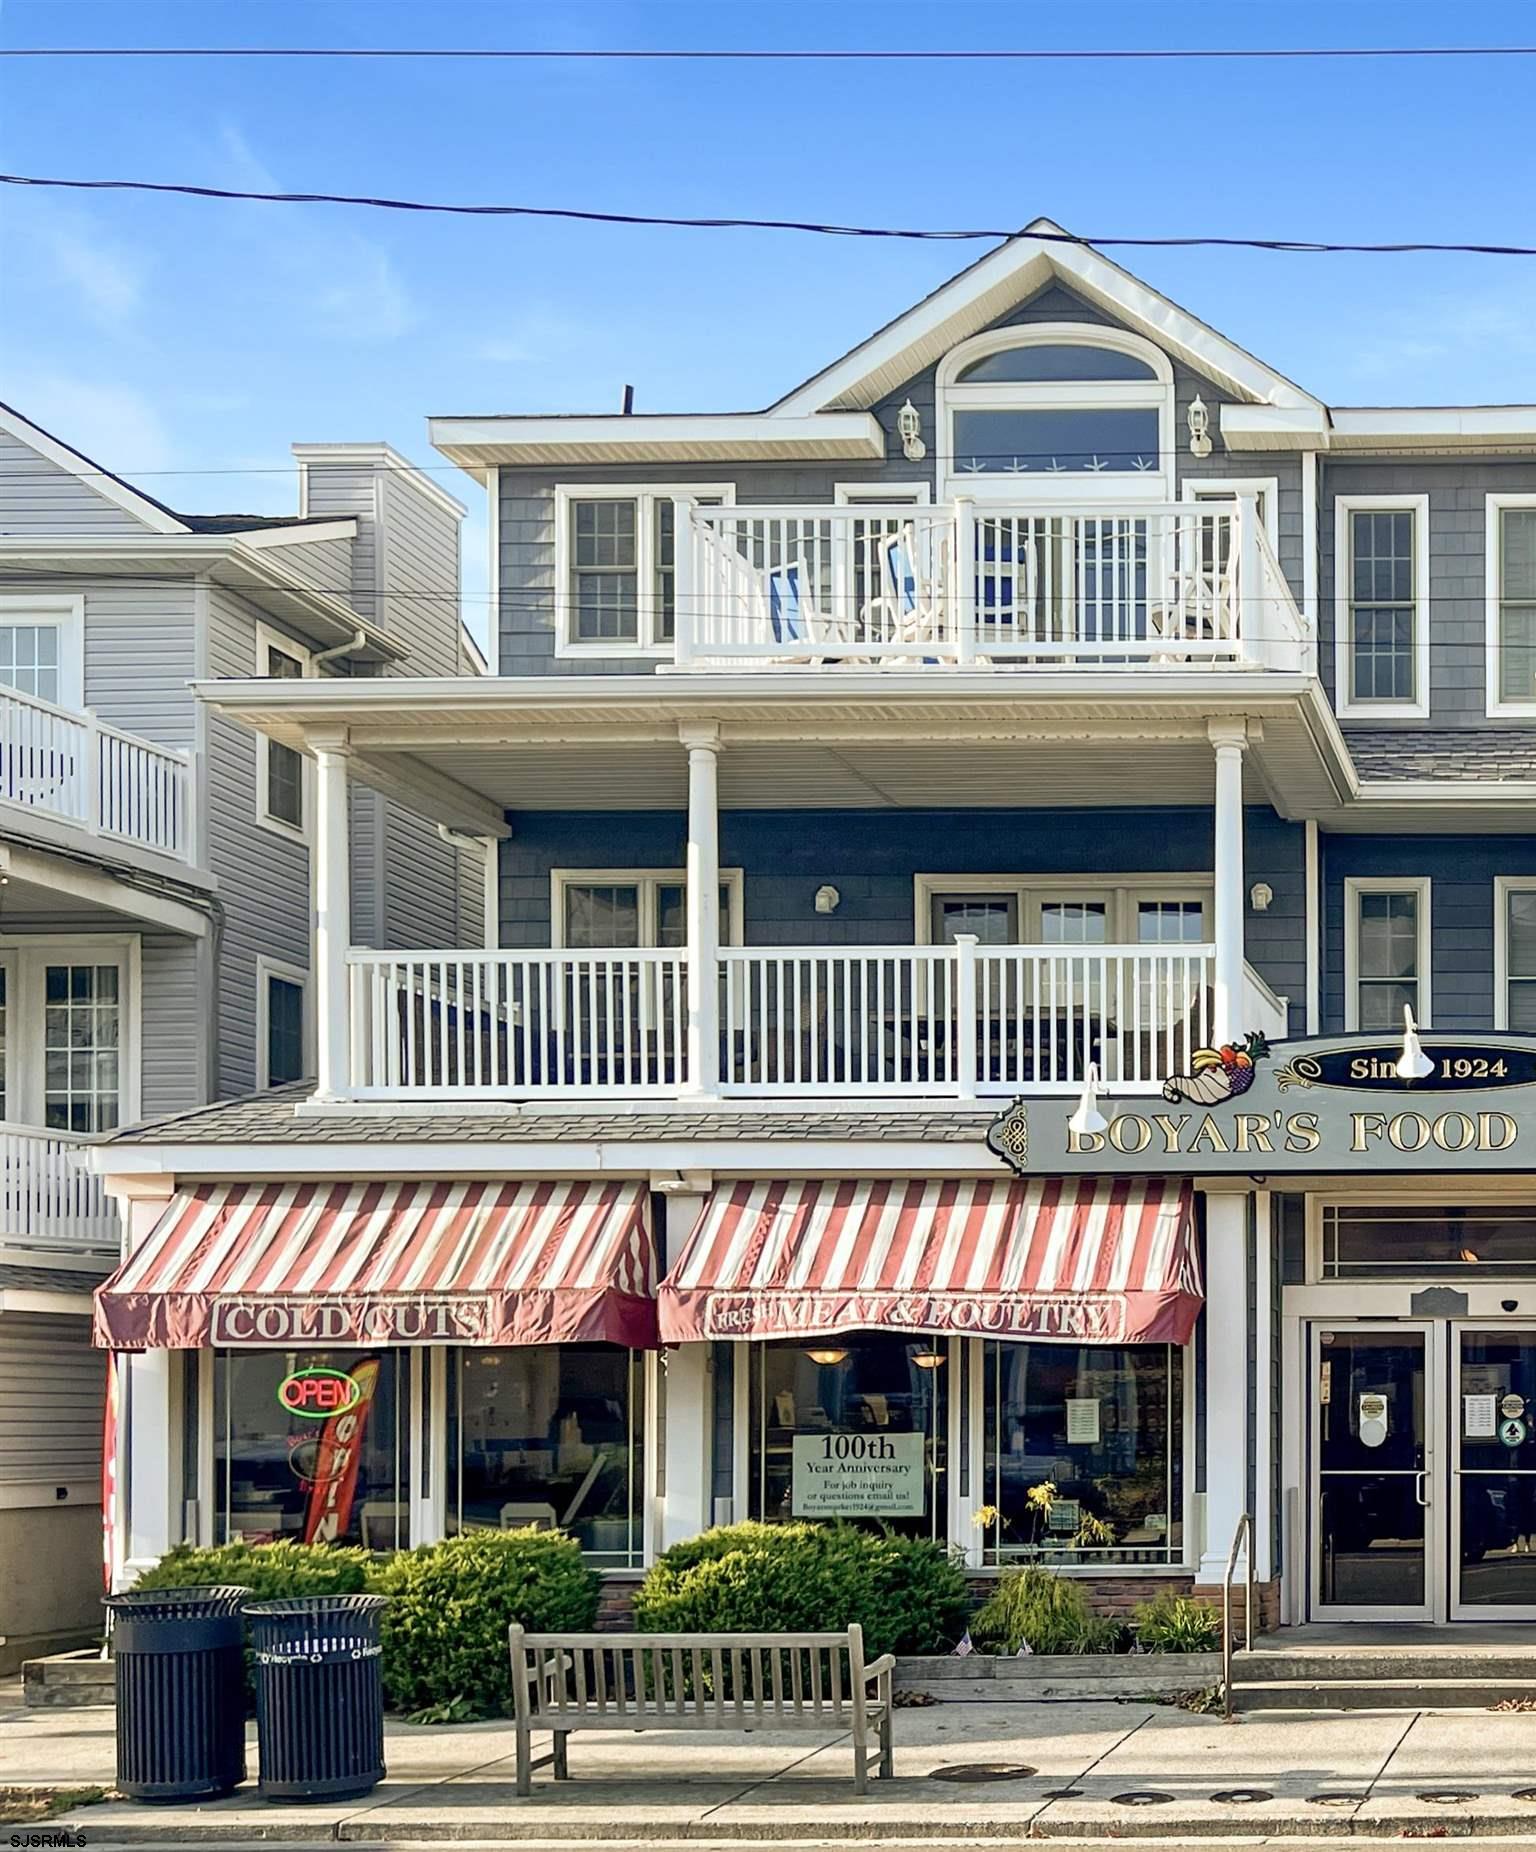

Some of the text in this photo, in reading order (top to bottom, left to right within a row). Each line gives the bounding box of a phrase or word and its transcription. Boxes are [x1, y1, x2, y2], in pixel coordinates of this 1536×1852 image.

[1440, 1058, 1507, 1078] 1924
[1350, 1112, 1518, 1151] FOOD
[225, 1302, 481, 1339] COLD CUTS
[717, 1299, 1111, 1335] FRESH MEAT & POULTRY
[283, 1380, 351, 1406] OPEN
[821, 1435, 896, 1459] 100th
[807, 1462, 911, 1476] Year Anniversary
[820, 1492, 865, 1502] questions
[867, 1490, 893, 1500] email
[823, 1480, 893, 1491] For job inquiry
